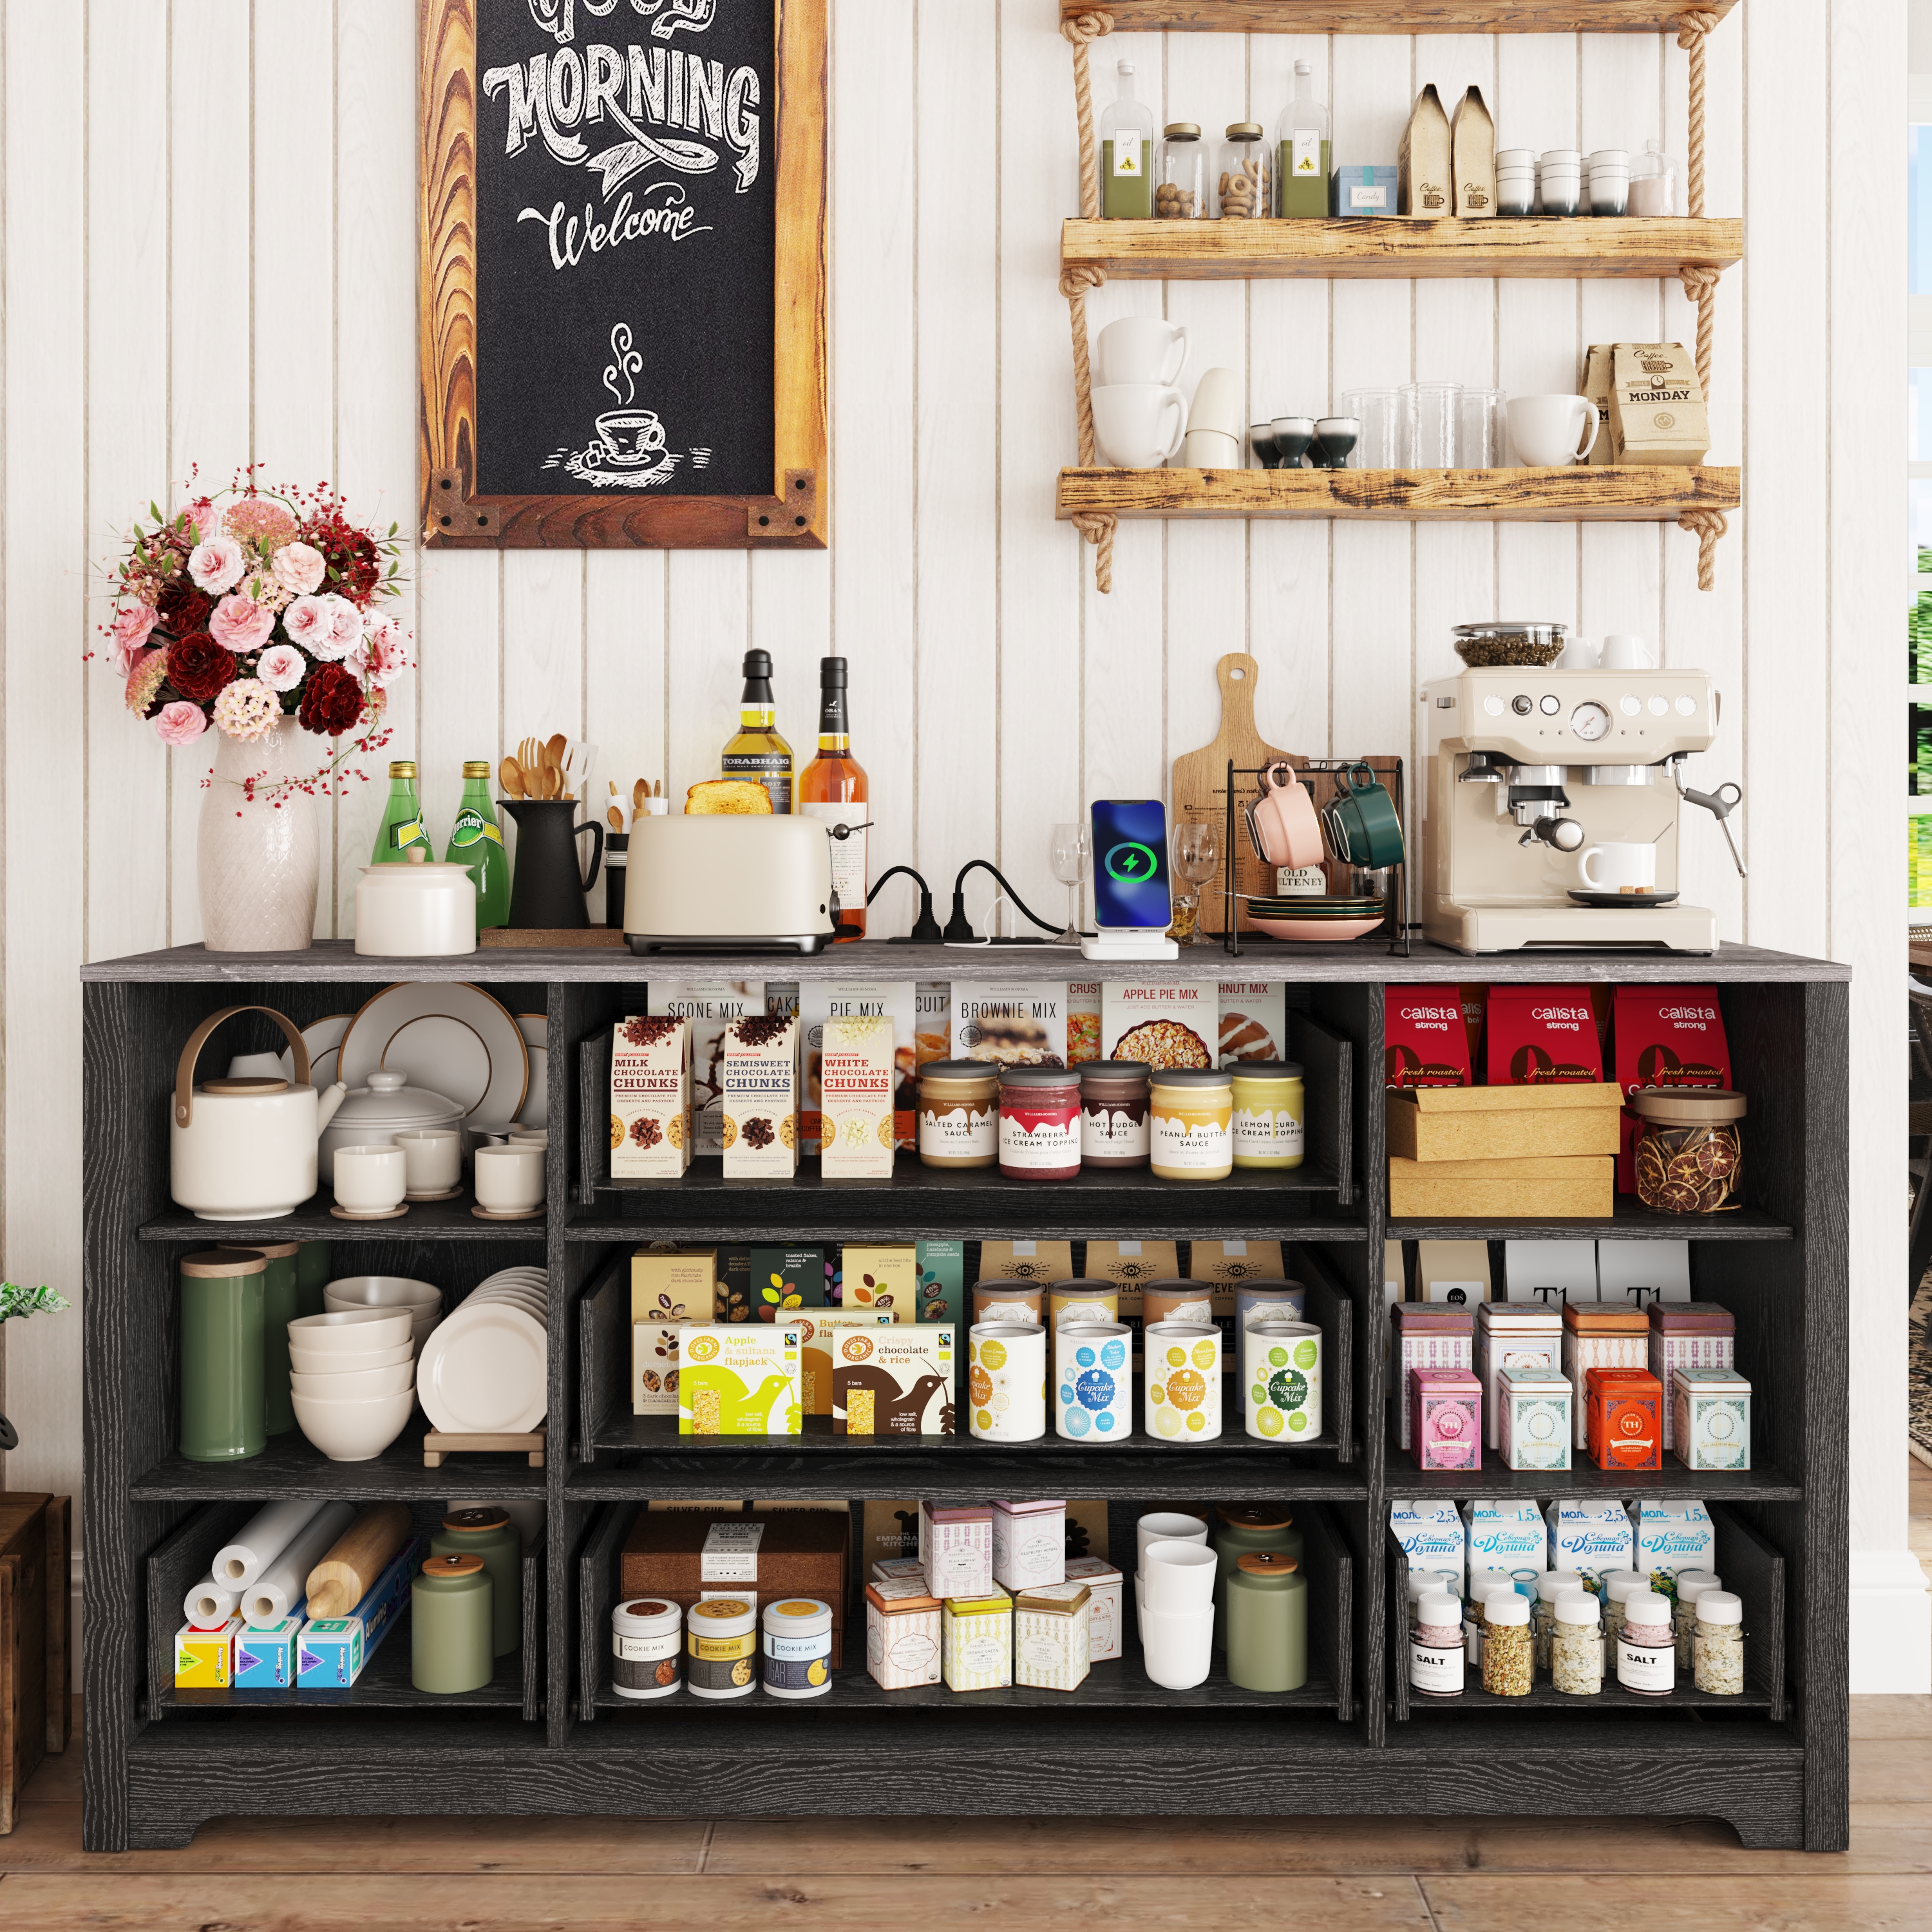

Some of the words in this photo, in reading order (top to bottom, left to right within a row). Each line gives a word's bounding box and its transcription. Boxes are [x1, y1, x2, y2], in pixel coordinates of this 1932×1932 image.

[482, 43, 761, 200] MORNING
[1123, 138, 1133, 146] oil
[1302, 138, 1312, 146] oil
[1357, 192, 1380, 201] Candy
[517, 182, 713, 270] Welcome
[1642, 361, 1667, 370] EVERYDAY
[1629, 391, 1690, 402] MONDAY
[1123, 989, 1156, 999] APPLE
[1159, 989, 1175, 999] PIE
[1179, 989, 1198, 999] MIX
[1249, 984, 1268, 993] MIX
[668, 1003, 712, 1018] SCONE
[719, 1003, 744, 1018] MIX
[860, 1003, 884, 1017] MIX
[961, 1003, 1024, 1018] BROWNIE
[1032, 1003, 1056, 1018] MIX
[1415, 1022, 1448, 1031] strong
[1546, 1021, 1579, 1030] strong
[1674, 1022, 1706, 1030] strong
[1392, 1067, 1426, 1078] fresh
[1524, 1067, 1558, 1078] fresh
[1558, 1067, 1596, 1075] roasted
[1652, 1067, 1685, 1077] fresh
[614, 1079, 677, 1087] CHUNKS
[726, 1079, 790, 1088] CHUNKS
[824, 1079, 889, 1088] CHUNKS
[1047, 1138, 1077, 1146] TOPPING
[717, 1283, 727, 1295] new
[659, 1295, 670, 1307] new
[786, 1296, 797, 1305] 40%
[1533, 1287, 1567, 1307] T1
[1627, 1287, 1660, 1308] T1
[690, 1338, 702, 1352] DOVES
[704, 1337, 717, 1347] FARM
[724, 1336, 756, 1346] Apple
[844, 1338, 857, 1352] DOVES
[858, 1338, 871, 1347] FARM
[878, 1336, 913, 1346] Crispy
[692, 1349, 717, 1360] ORGANIC
[846, 1349, 871, 1360] ORGANIC
[724, 1358, 768, 1367] flapjack
[1078, 1381, 1113, 1394] Cupcake
[1169, 1381, 1203, 1394] Cupcake
[1271, 1381, 1305, 1394] Cupcake
[972, 1388, 987, 1400] Mix
[1088, 1392, 1110, 1403] Mix
[1179, 1392, 1200, 1403] Mix
[1281, 1392, 1302, 1403] Mix
[1517, 1509, 1542, 1522] 1,5%
[1684, 1509, 1709, 1522] 1,5%
[1416, 1532, 1451, 1543] Северная
[1496, 1531, 1531, 1542] Северная
[1585, 1531, 1620, 1542] Северная
[1664, 1531, 1698, 1542] Северная
[1397, 1537, 1455, 1555] Долина
[1473, 1535, 1535, 1554] Долина
[1561, 1535, 1624, 1554] Долина
[1641, 1535, 1703, 1554] Долина
[1416, 1654, 1446, 1665] SALT
[1627, 1653, 1656, 1664] SALT
